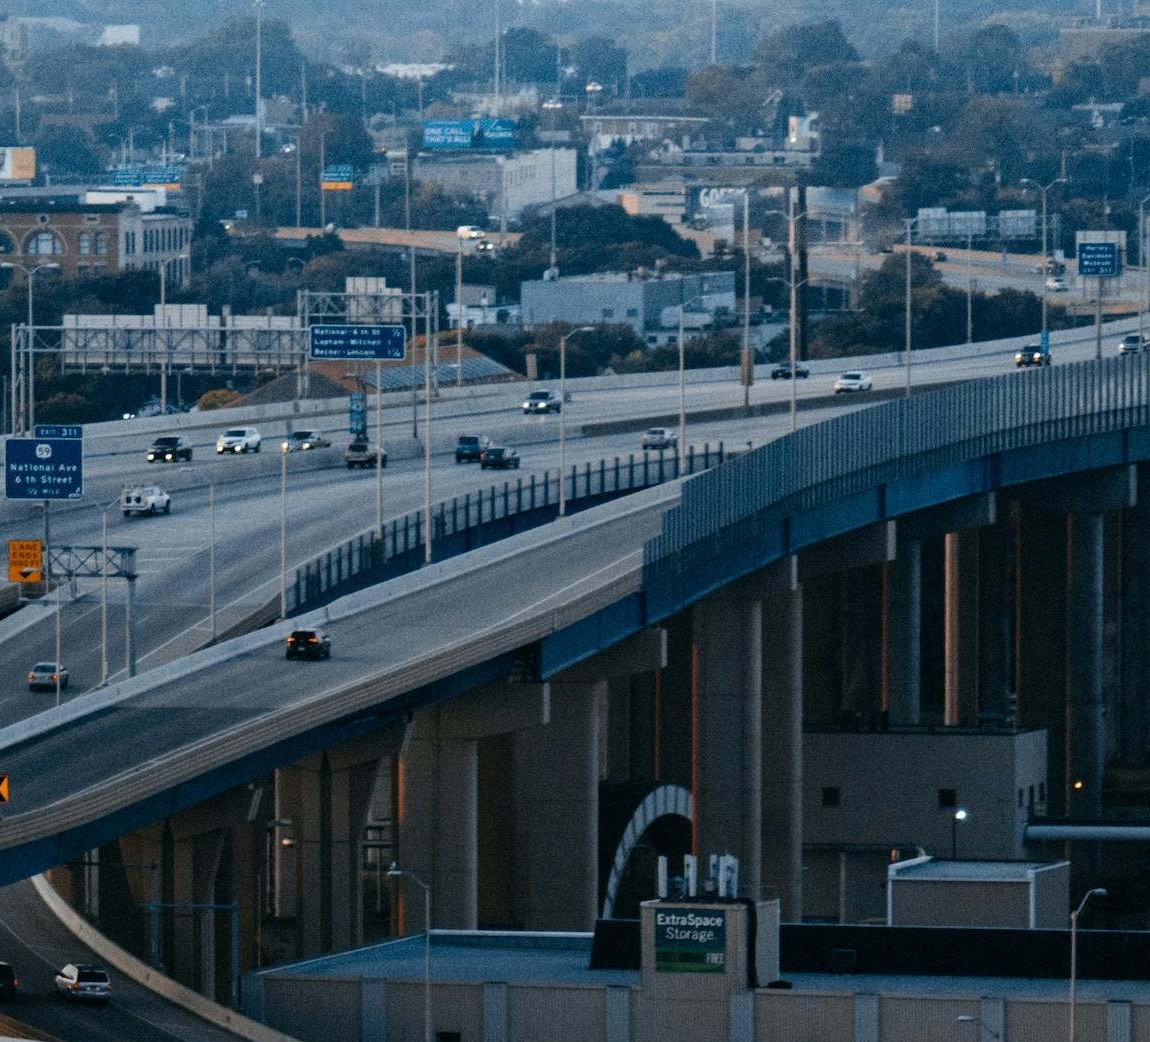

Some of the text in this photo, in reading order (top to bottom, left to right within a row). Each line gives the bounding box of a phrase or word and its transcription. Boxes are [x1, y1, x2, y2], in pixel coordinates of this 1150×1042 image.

[61, 428, 77, 436] 311
[38, 447, 50, 456] 59
[10, 464, 78, 472] National Ave
[41, 475, 72, 484] Street
[12, 543, 38, 551] LANE
[12, 552, 38, 560] ENDS
[657, 913, 723, 928] ExtraSpace
[665, 926, 714, 943] Storage
[706, 952, 725, 965] FREE
